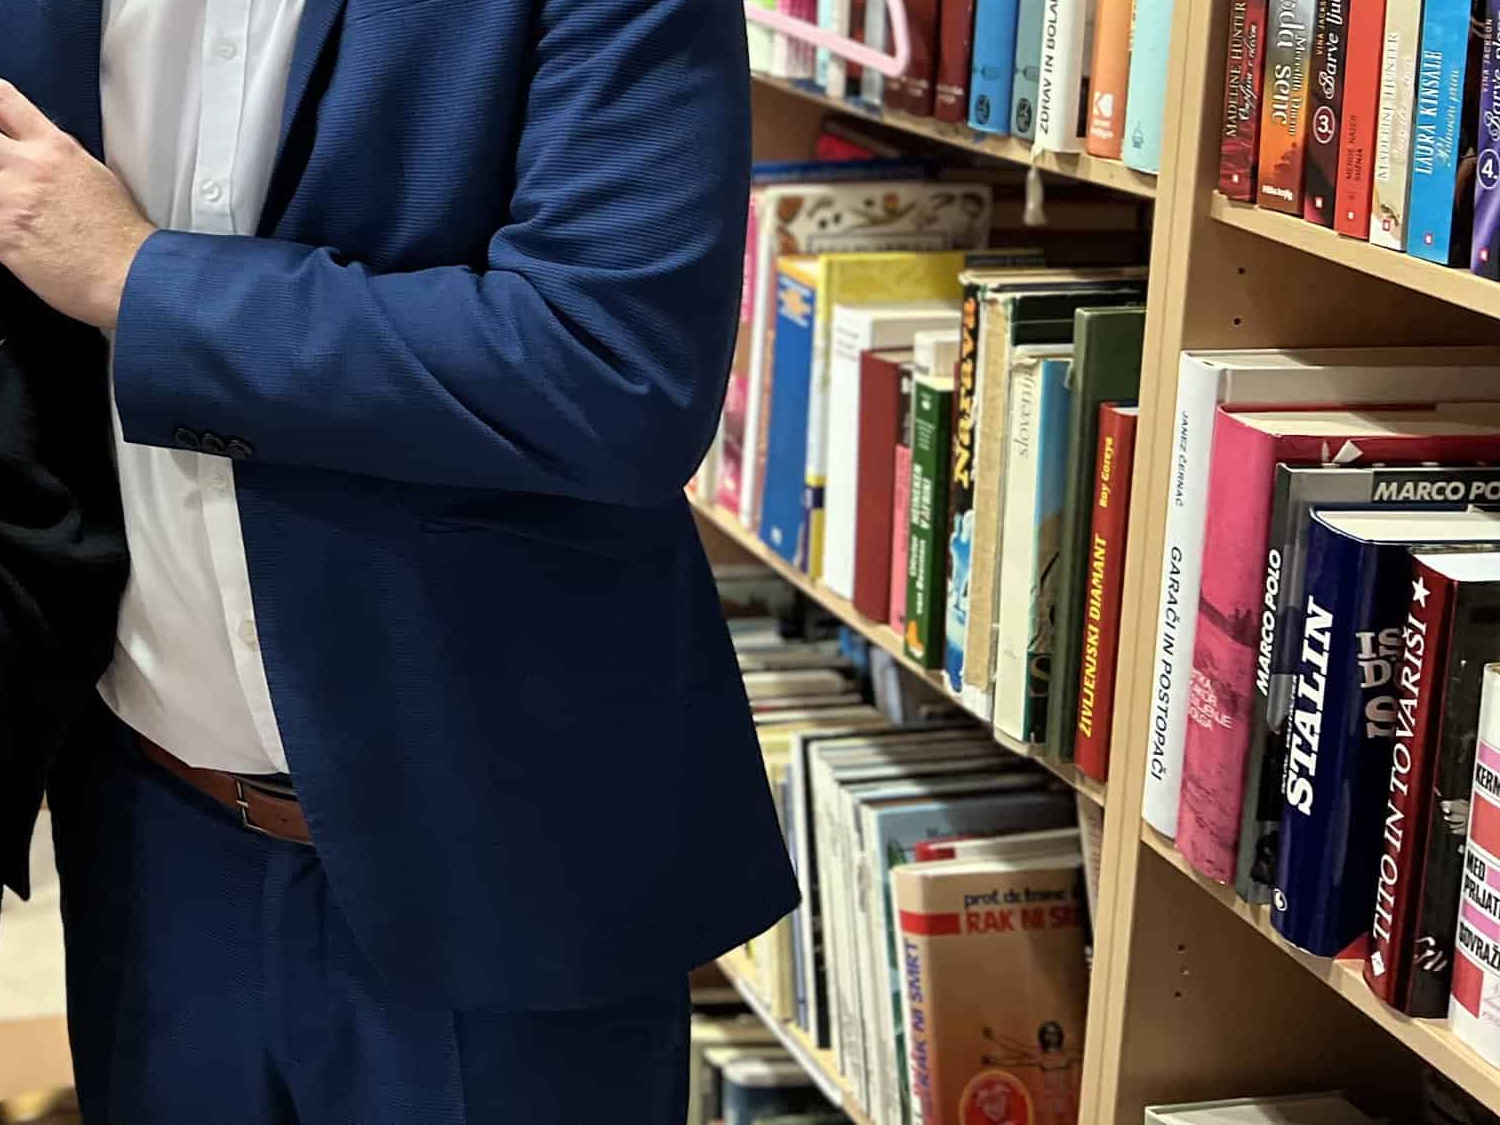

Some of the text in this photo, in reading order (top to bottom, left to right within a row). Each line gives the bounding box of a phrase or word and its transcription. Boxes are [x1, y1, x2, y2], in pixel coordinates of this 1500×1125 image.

[1040, 77, 1053, 134] ZDRAV
[1043, 55, 1054, 74] IN
[1225, 1, 1247, 137] MADELINE HUNTER
[1318, 32, 1339, 100] Barve
[1414, 50, 1444, 175] LAURA KINSALE
[952, 297, 978, 490] Narava
[1177, 410, 1189, 453] JANEZ
[1374, 481, 1466, 501] MARCO
[1082, 533, 1109, 621] DIAMANT
[1255, 548, 1282, 697] MARCO POLO
[1150, 545, 1184, 781] GARAČI IN POSTOPAČI
[1286, 596, 1333, 816] STALIN
[1372, 610, 1428, 944] TITO IN TOVARIŠI
[965, 909, 1014, 933] RAK
